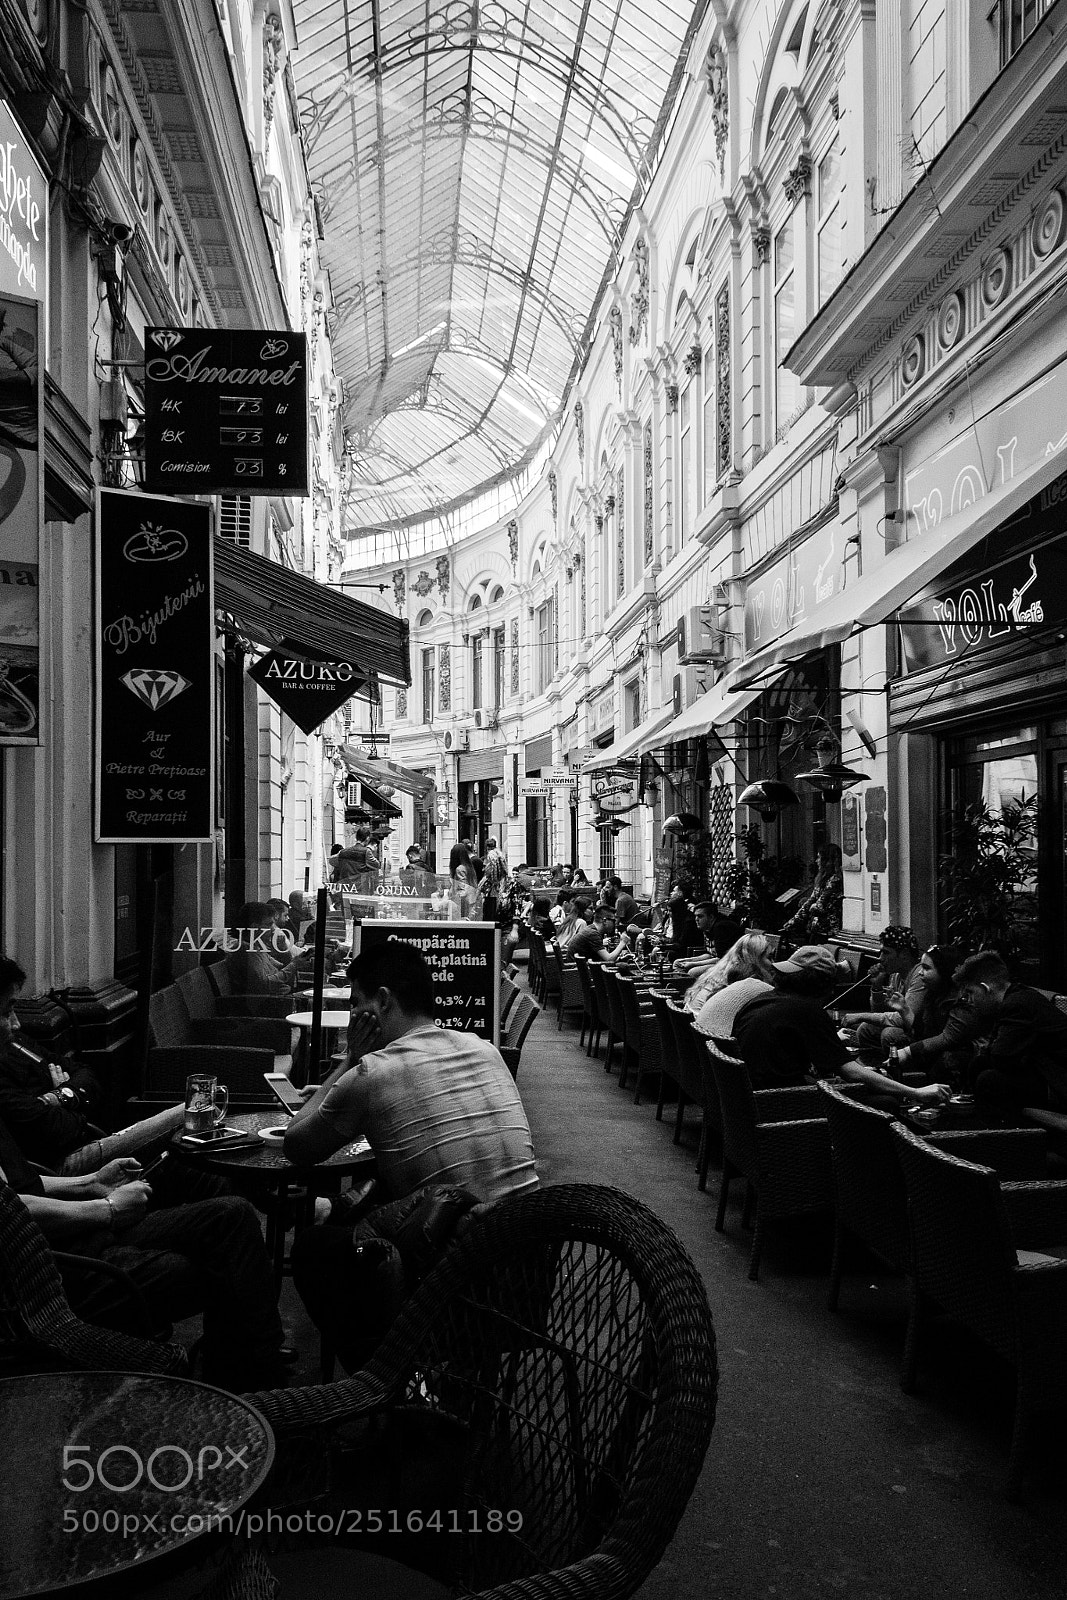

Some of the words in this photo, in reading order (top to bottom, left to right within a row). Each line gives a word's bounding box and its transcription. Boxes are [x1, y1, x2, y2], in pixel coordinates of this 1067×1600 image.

[146, 345, 303, 386] Amanet
[161, 398, 183, 414] 14K
[275, 403, 289, 414] lei
[160, 429, 186, 443] 18K
[236, 431, 261, 443] 93
[275, 433, 289, 444] lei
[278, 463, 287, 475] %
[103, 573, 205, 655] Bijuterii
[264, 659, 354, 682] AZUKO
[282, 681, 298, 690] BAR
[305, 683, 336, 691] COFFEE
[142, 730, 171, 743] Aur
[150, 746, 166, 759] &
[105, 762, 145, 775] Pietre
[173, 926, 295, 953] AZUKO
[435, 995, 464, 1007] 0,3%
[474, 996, 486, 1006] zi
[474, 1018, 485, 1028] zi
